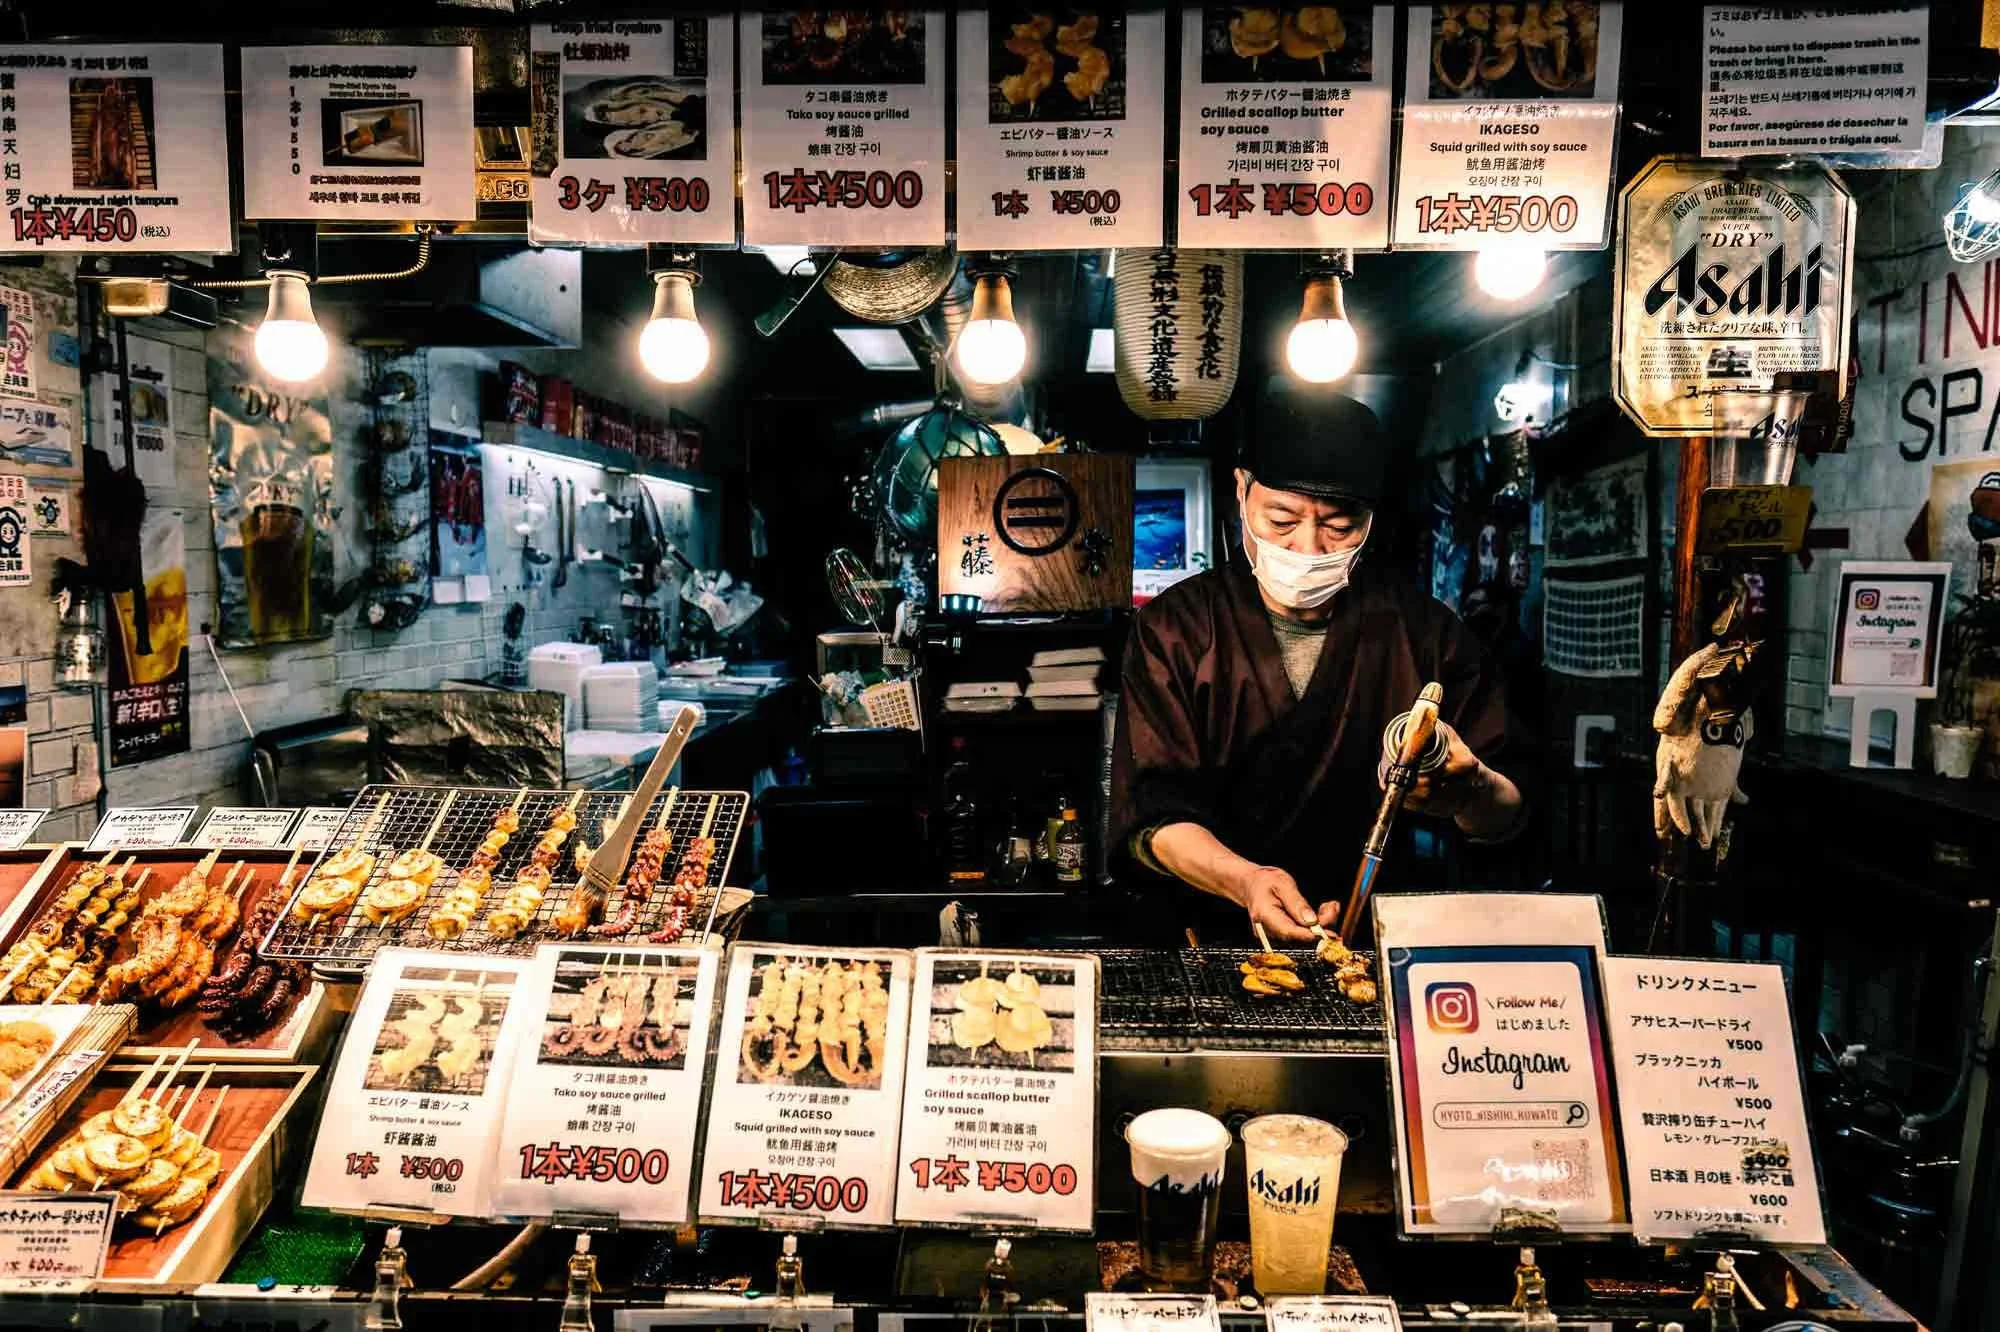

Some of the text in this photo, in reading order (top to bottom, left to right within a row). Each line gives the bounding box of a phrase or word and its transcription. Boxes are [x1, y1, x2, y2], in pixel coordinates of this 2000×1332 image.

[1709, 36, 1921, 54] Please be sure to dispose trash in the
[1709, 54, 1827, 69] trash or bring it here.
[786, 108, 910, 121] Tako soy sauce grilled
[1201, 105, 1345, 120] Grilled scallop butter
[1200, 124, 1270, 137] soy sauce
[1479, 124, 1540, 136] IKAGESO
[1709, 116, 1909, 133] Por favor, asegúrese de desechar la
[1430, 142, 1588, 155] Squid grilled with soy sauce
[1708, 133, 1902, 149] basura en la basura o tráigala aquí.
[834, 142, 881, 156] 간장 구이
[1006, 148, 1110, 159] Shrimp butter & soy sauce
[1226, 159, 1341, 173] 가리비 버터 간장 구이
[1467, 175, 1499, 187] 오징어
[1523, 175, 1543, 187] 구이
[558, 175, 710, 212] 3ケ ¥500
[763, 168, 924, 214] 1本¥500
[992, 189, 1122, 220] 1本 ¥500
[1189, 178, 1374, 220] 1本 ¥500
[1672, 182, 1801, 222] ASAHI BREWERIES LIMITED
[1416, 193, 1578, 234] 1本¥500
[10, 206, 138, 245] 1本¥450
[1089, 216, 1118, 227] (税込)
[1721, 223, 1751, 231] SUPER
[1643, 241, 1825, 318] Asahi
[1636, 974, 1758, 993] ドリンクメニュー
[1497, 996, 1559, 1009] Follow Me
[1496, 1017, 1571, 1031] はじめました
[1631, 1014, 1752, 1032] アサヒスーパードライ
[1726, 1039, 1763, 1051] ¥500
[1441, 1046, 1571, 1090] Instagram
[1634, 1053, 1722, 1069] ブラックニッカ
[1697, 1075, 1760, 1090] ハイボール
[553, 1087, 667, 1102] Tako soy sauce grilled
[924, 1088, 1051, 1104] Grilled scallop butter
[924, 1104, 985, 1116] soy sauce
[1735, 1097, 1773, 1110] ¥500
[395, 1115, 417, 1124] butter
[779, 1108, 833, 1121] IKAGESO
[591, 1120, 637, 1134] 간장 구이
[733, 1121, 876, 1138] Squid grilled with soy sauce
[946, 1136, 1048, 1153] 가리비 버터 간장 구이
[345, 1152, 464, 1182] 1本 ¥500
[520, 1142, 670, 1185] 1本¥500
[817, 1156, 836, 1168] 구이
[910, 1154, 1077, 1196] 1本 ¥500
[1650, 1168, 1689, 1184] 日本酒
[431, 1182, 457, 1193] (税込)
[719, 1168, 868, 1213] 1本¥500
[1250, 1168, 1321, 1206] Asahi
[1749, 1194, 1789, 1207] ¥600
